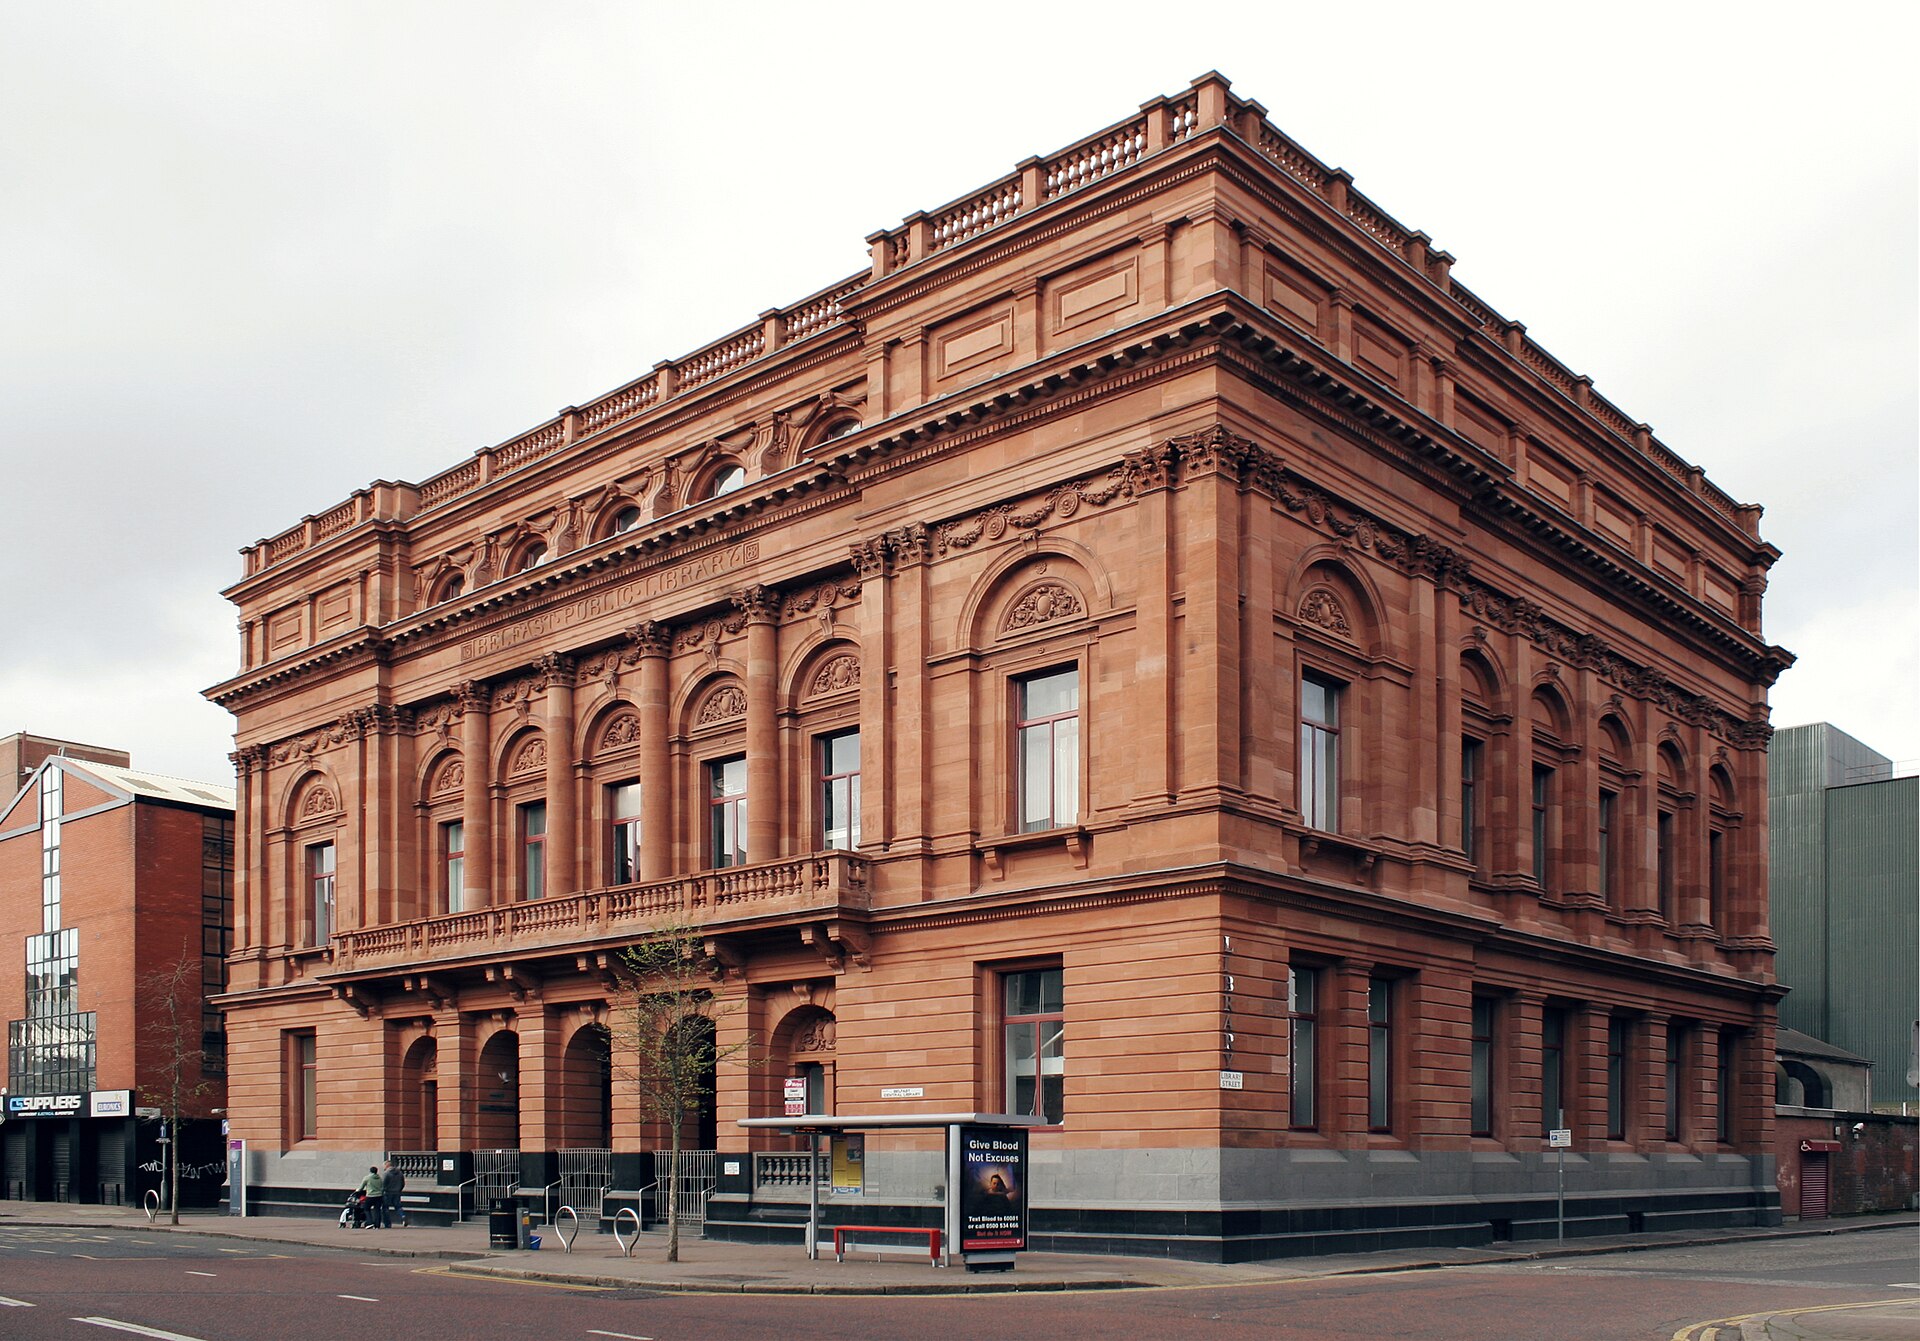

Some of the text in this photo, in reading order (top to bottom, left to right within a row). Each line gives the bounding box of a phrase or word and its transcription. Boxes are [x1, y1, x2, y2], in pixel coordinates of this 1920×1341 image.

[475, 546, 740, 654] BELFAST PUBLIC LIBRARY
[969, 1140, 1019, 1150] Give Blood
[968, 1152, 1019, 1163] Not Excuses
